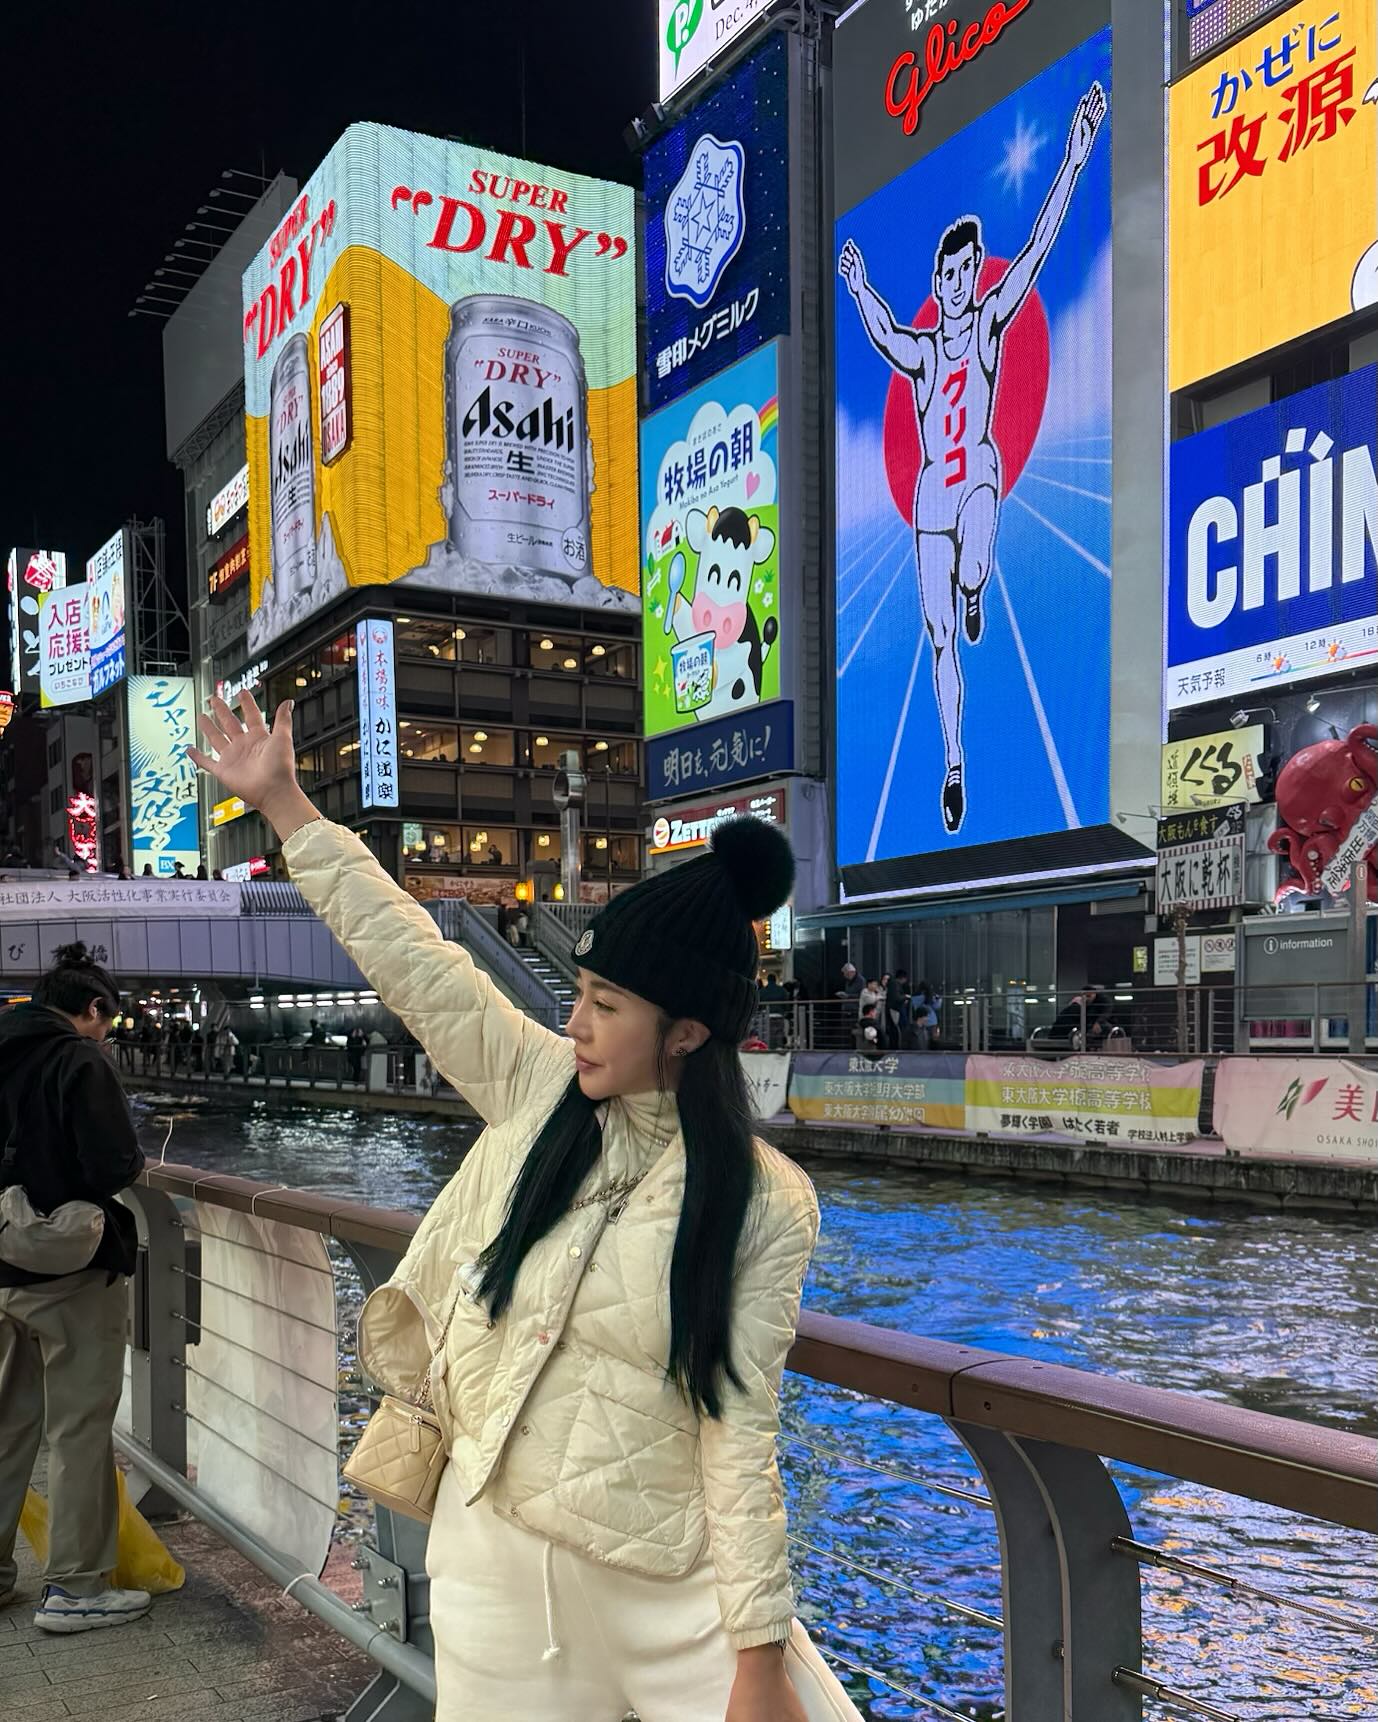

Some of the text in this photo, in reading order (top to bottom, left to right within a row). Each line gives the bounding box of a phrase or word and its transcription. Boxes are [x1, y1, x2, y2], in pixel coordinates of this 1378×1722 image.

[716, 7, 743, 40] Dec.
[884, 0, 1030, 136] Glico
[1211, 12, 1342, 119] かぜに
[1197, 46, 1357, 207] 改源
[468, 169, 569, 214] SUPER
[270, 194, 309, 268] SUPER
[390, 185, 629, 277] “DRY”
[321, 315, 344, 372] ASAHI
[498, 348, 540, 364] SUPER
[655, 288, 760, 378] 雪印メグミルク
[462, 385, 574, 454] Asahi
[942, 358, 969, 489] グリコ
[506, 450, 535, 475] 生
[665, 420, 753, 506] 牧場の朝
[488, 489, 555, 510] スーパードライ
[48, 599, 81, 631] 入店
[1362, 626, 1378, 638] 18
[1177, 667, 1226, 697] 天気予報
[146, 680, 197, 801] シャッターは
[375, 717, 394, 799] かに道楽
[1180, 742, 1242, 795] くくる
[67, 888, 232, 904] 大阪活性化事業実行委員会
[1160, 849, 1230, 901] 大阪に乾杯
[1280, 937, 1333, 950] information
[1332, 1083, 1378, 1122] 美
[1316, 1134, 1352, 1145] OSAKA
